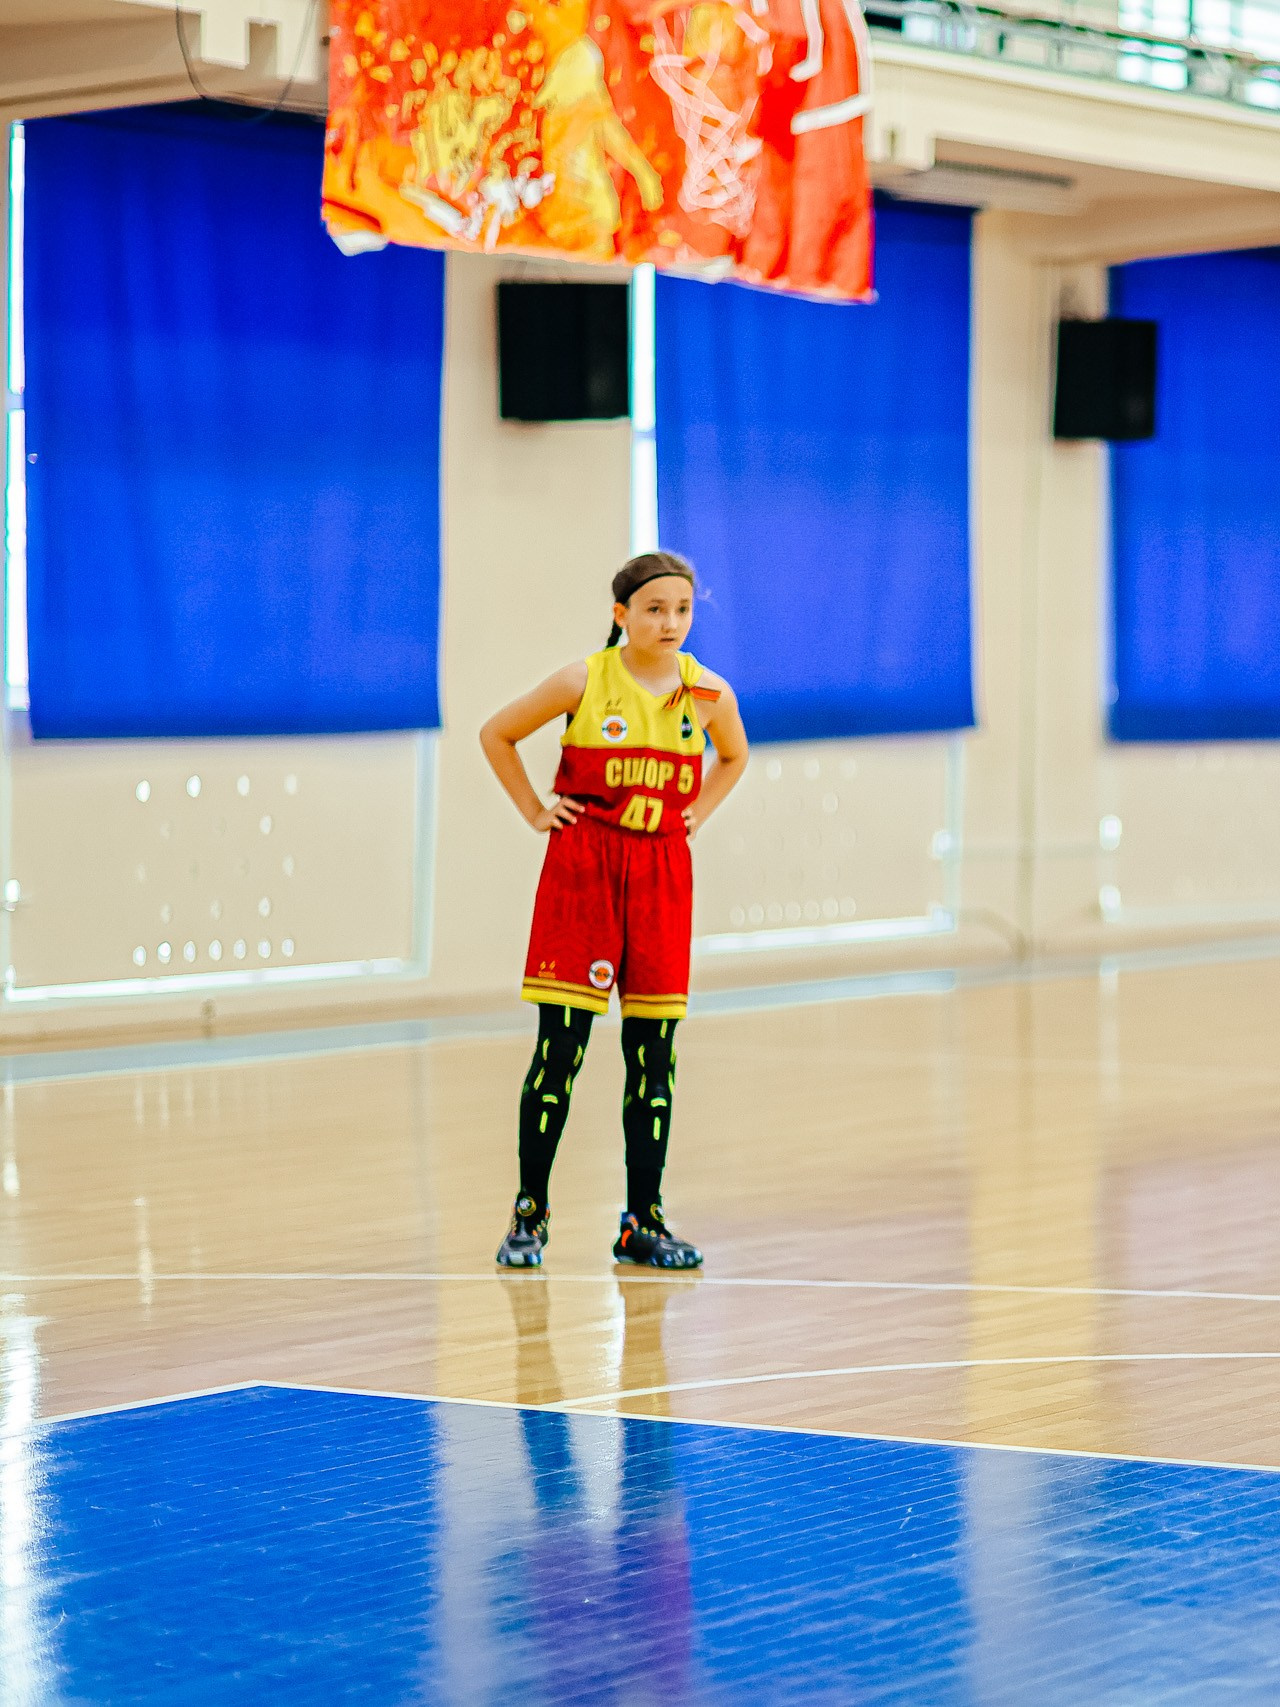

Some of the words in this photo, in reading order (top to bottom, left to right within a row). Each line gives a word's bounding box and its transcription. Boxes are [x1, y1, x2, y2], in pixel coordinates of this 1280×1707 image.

[605, 757, 675, 790] СШОР
[677, 763, 694, 794] 5
[620, 794, 664, 833] 47
